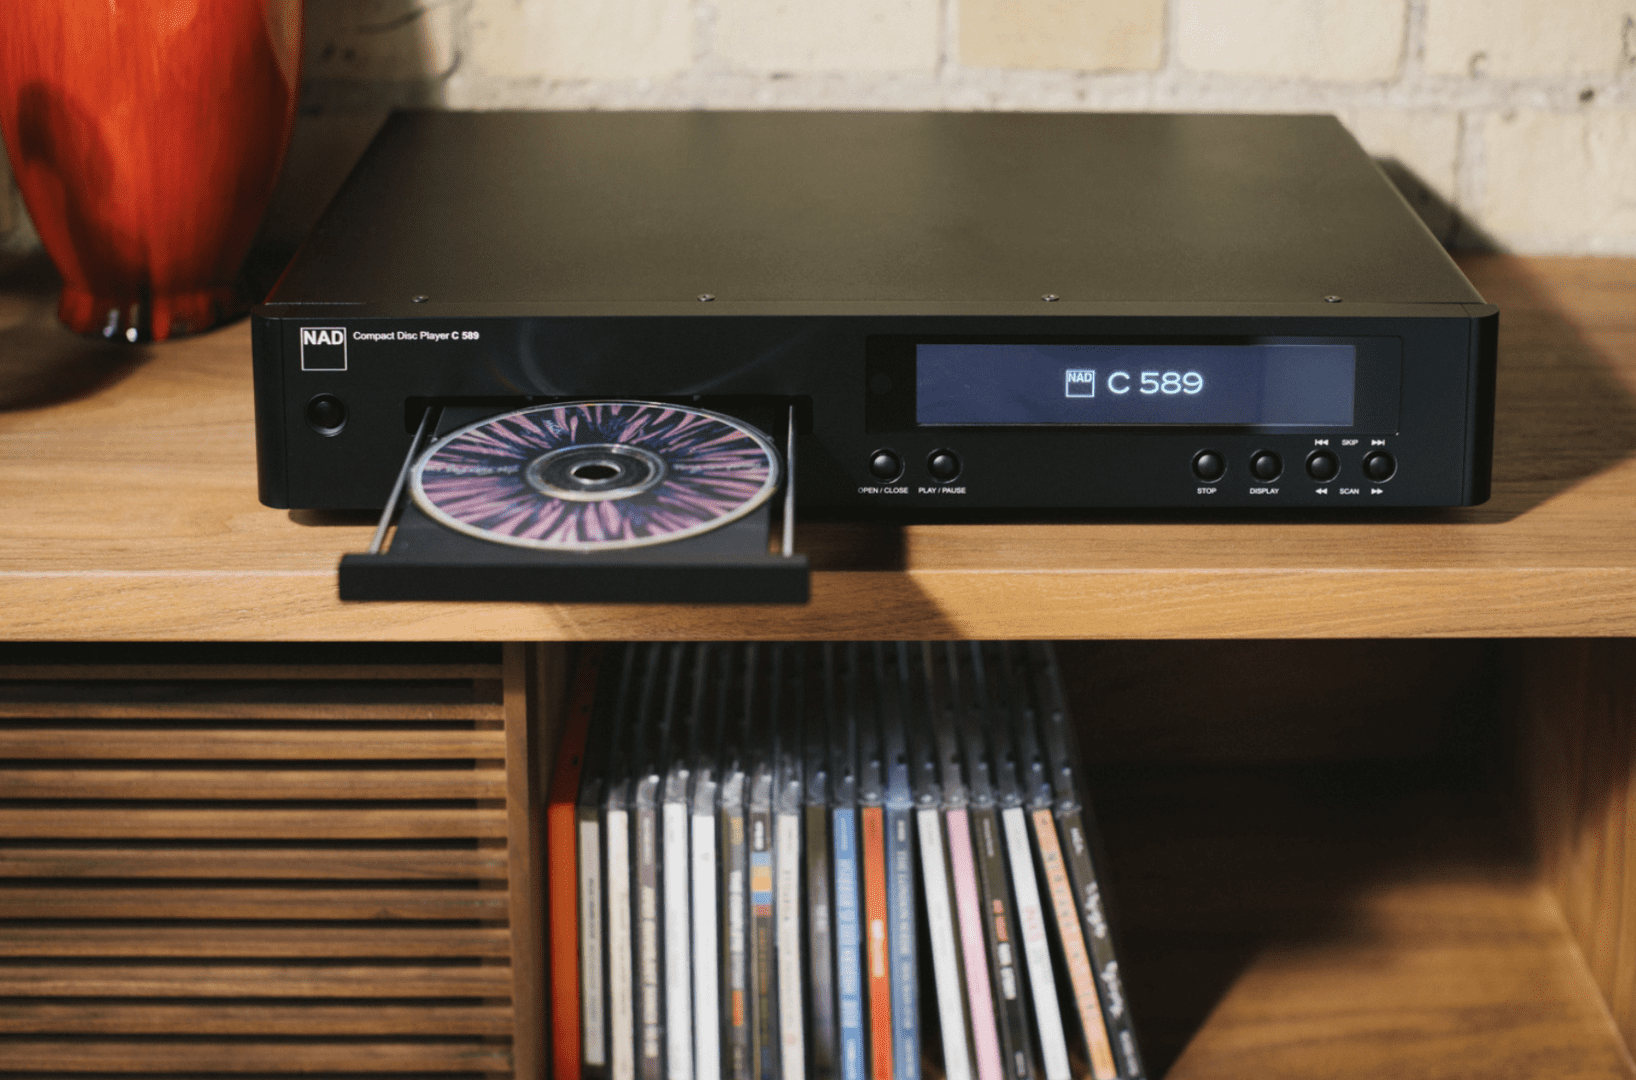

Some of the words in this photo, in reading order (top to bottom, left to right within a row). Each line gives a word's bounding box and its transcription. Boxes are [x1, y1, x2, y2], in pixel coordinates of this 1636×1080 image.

[303, 330, 344, 345] NAD
[352, 331, 395, 343] Compact
[397, 331, 418, 341] Disc
[419, 331, 450, 343] Player
[450, 331, 460, 341] C
[461, 331, 480, 341] 589
[1068, 372, 1092, 383] NAD
[1107, 371, 1131, 394] C
[1139, 371, 1204, 394] 589
[1341, 438, 1359, 446] SKIP
[858, 486, 878, 494] OPEN
[883, 486, 909, 494] CLOSE
[918, 486, 937, 494] PLAY
[941, 486, 966, 494] PAUSE
[1196, 487, 1217, 495] STOP
[1249, 487, 1280, 495] DISPLAY
[1339, 487, 1360, 495] SCAN
